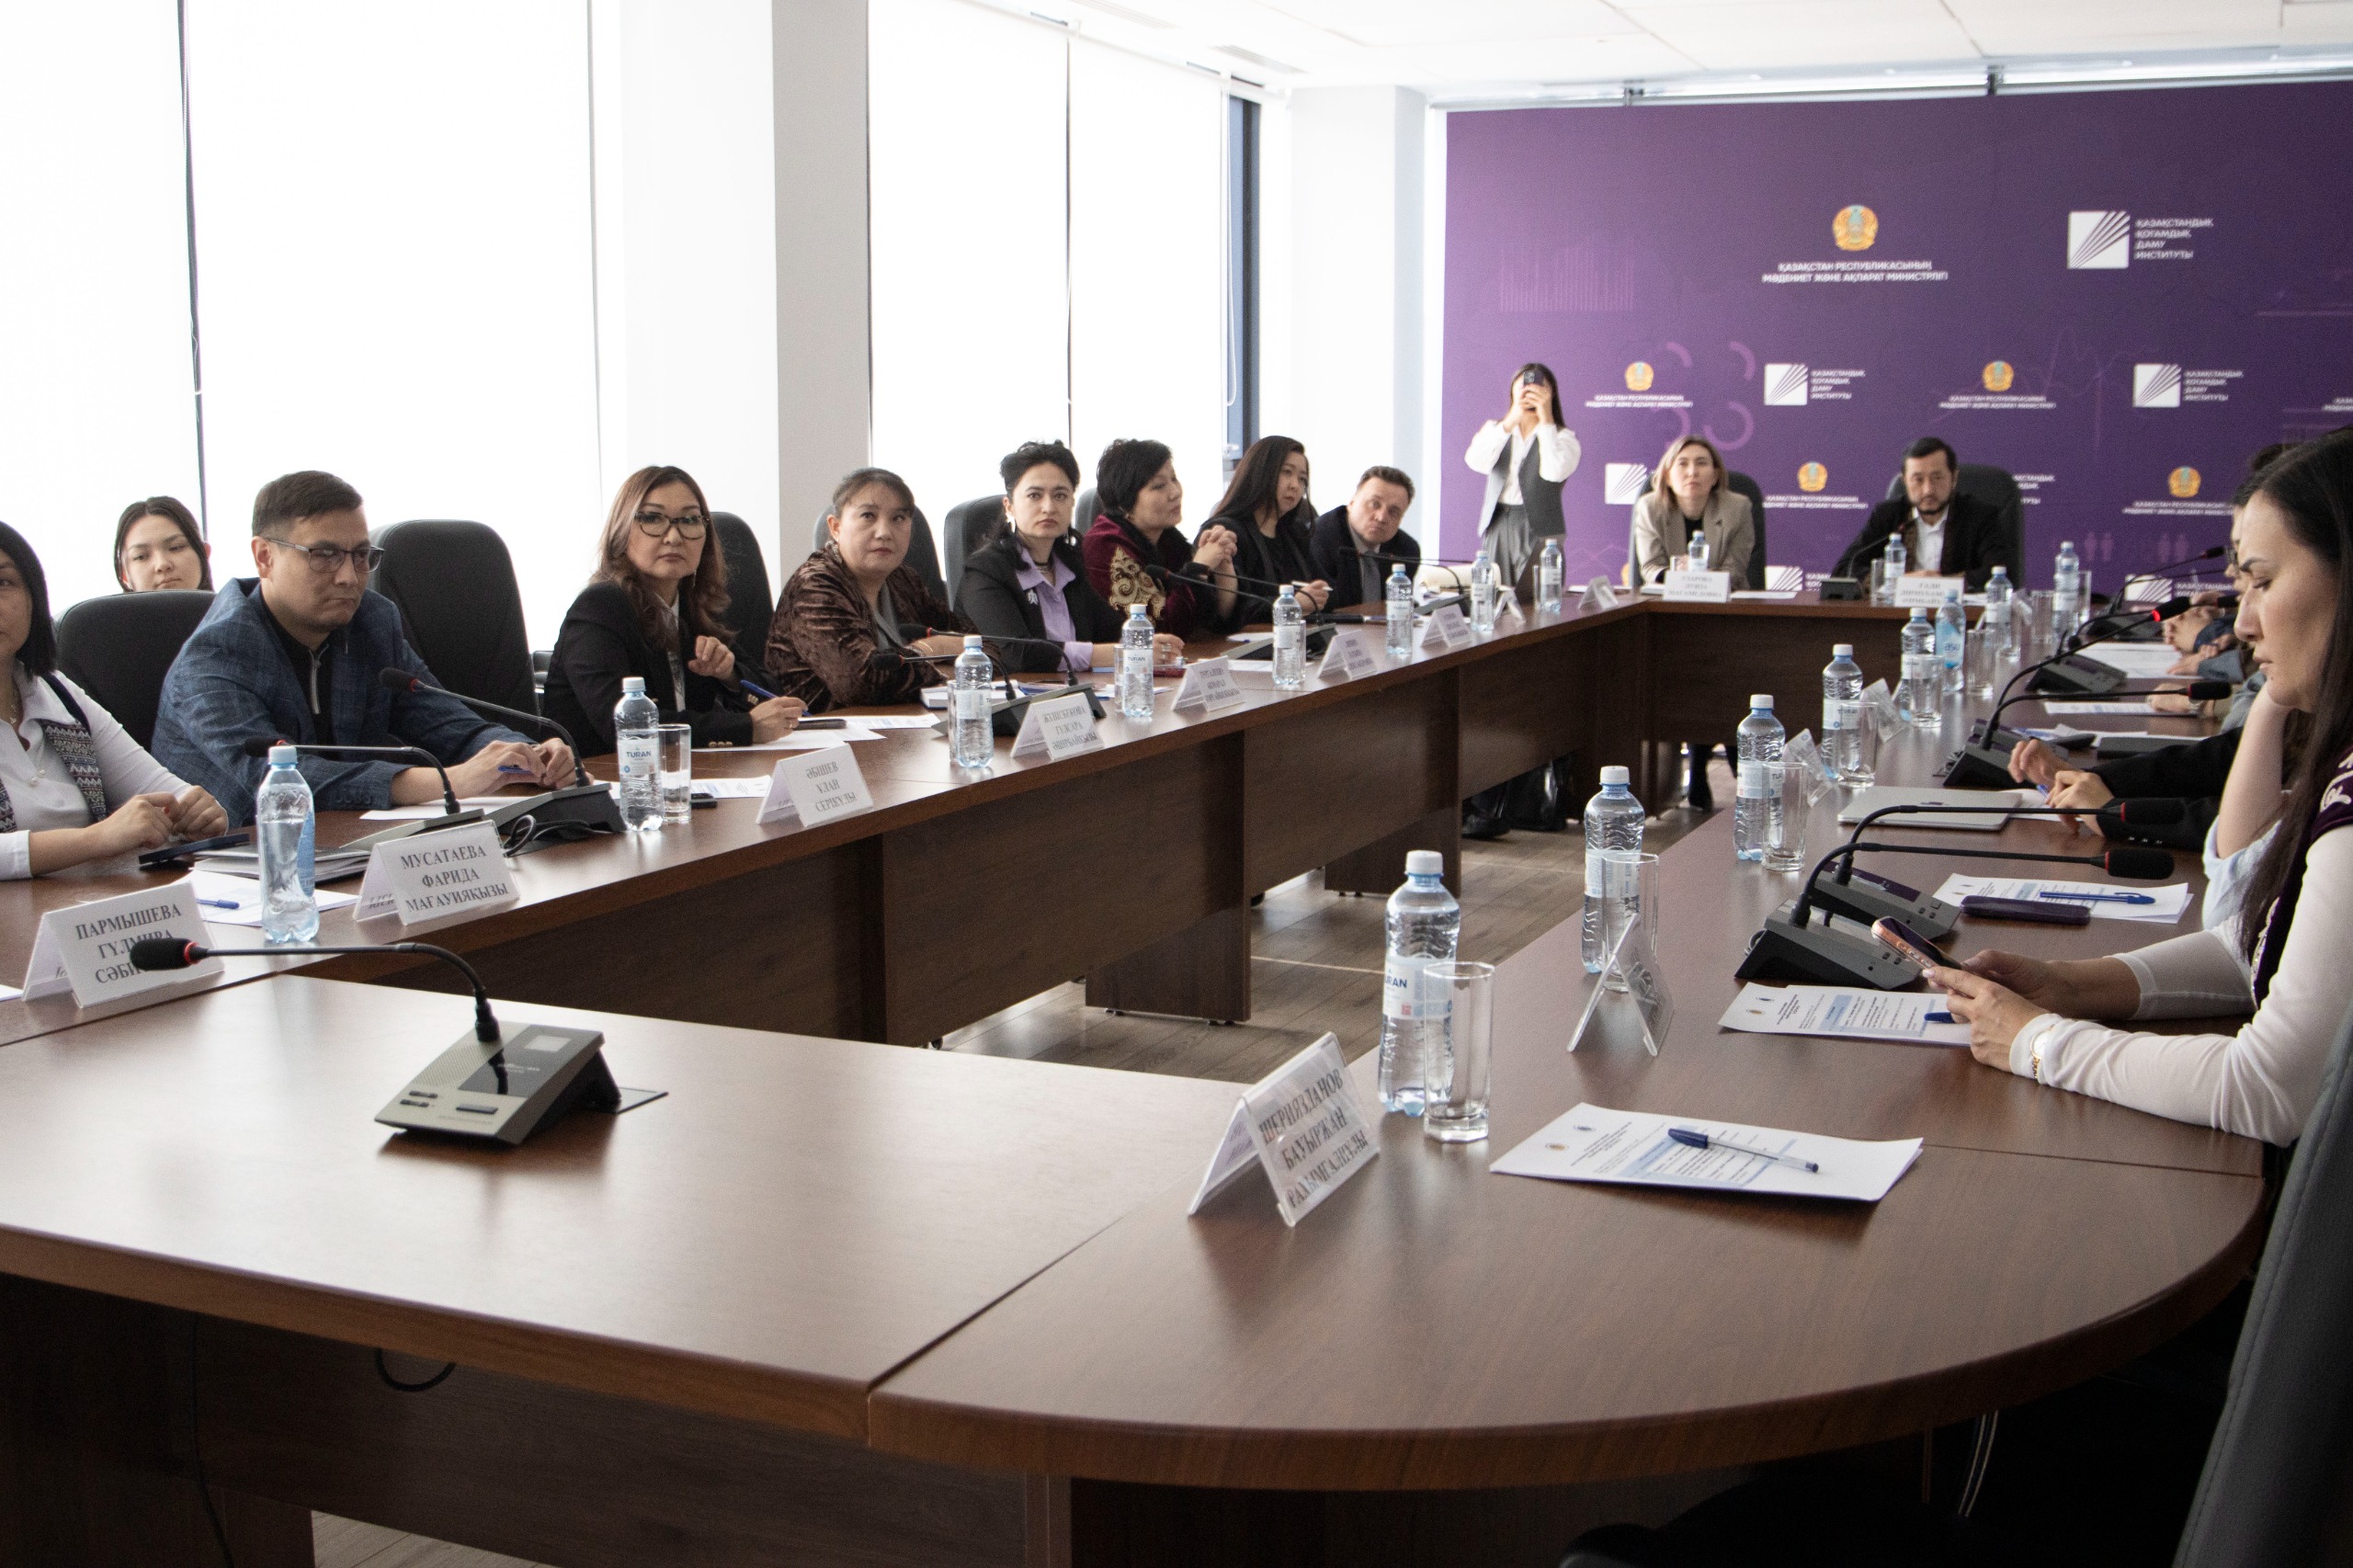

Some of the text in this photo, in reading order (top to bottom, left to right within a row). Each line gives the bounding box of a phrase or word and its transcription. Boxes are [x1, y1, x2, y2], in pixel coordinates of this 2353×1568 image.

[2134, 240, 2166, 249] ДАМУ
[2134, 250, 2194, 259] ИНСТИТУТЫ
[626, 750, 652, 758] TURAN
[401, 845, 487, 870] МУСАТАЕВА
[422, 867, 480, 888] ФАРИДА
[404, 883, 509, 913] МАҒАУИЯҚЫЗЫ
[74, 903, 183, 940] ПАРМЫШЕВА
[1258, 1068, 1344, 1145] ШЕРИЯЗДАНОВ
[1281, 1106, 1347, 1171] БАУЫРЖАН
